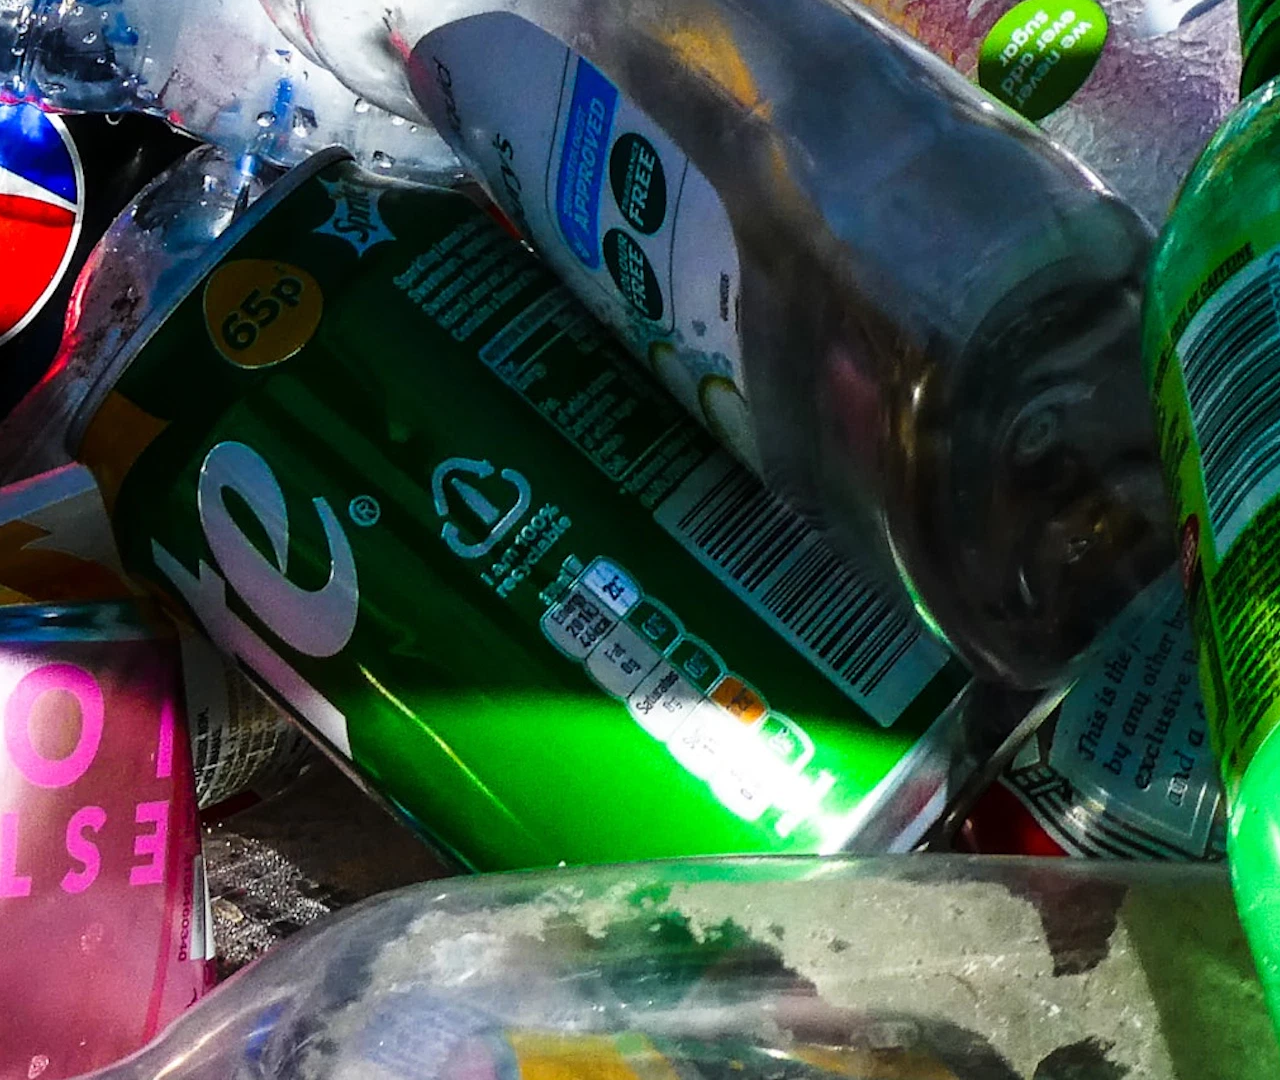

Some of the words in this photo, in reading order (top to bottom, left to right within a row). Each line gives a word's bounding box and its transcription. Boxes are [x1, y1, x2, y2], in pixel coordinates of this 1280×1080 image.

[990, 3, 1051, 70] sugar
[1032, 4, 1078, 55] ever
[1058, 15, 1093, 53] we
[573, 96, 606, 236] APPROVED
[628, 146, 656, 228] FREE
[217, 270, 307, 352] 65p
[627, 243, 650, 316] FREE
[495, 515, 573, 600] recyclable
[1094, 686, 1117, 708] is
[1102, 741, 1132, 776] by
[1122, 690, 1153, 737] any
[1143, 632, 1176, 687] other
[1104, 650, 1133, 685] the
[1078, 709, 1108, 761] This
[1135, 672, 1192, 789] exclusive
[1169, 749, 1196, 807] and
[1188, 728, 1204, 747] a
